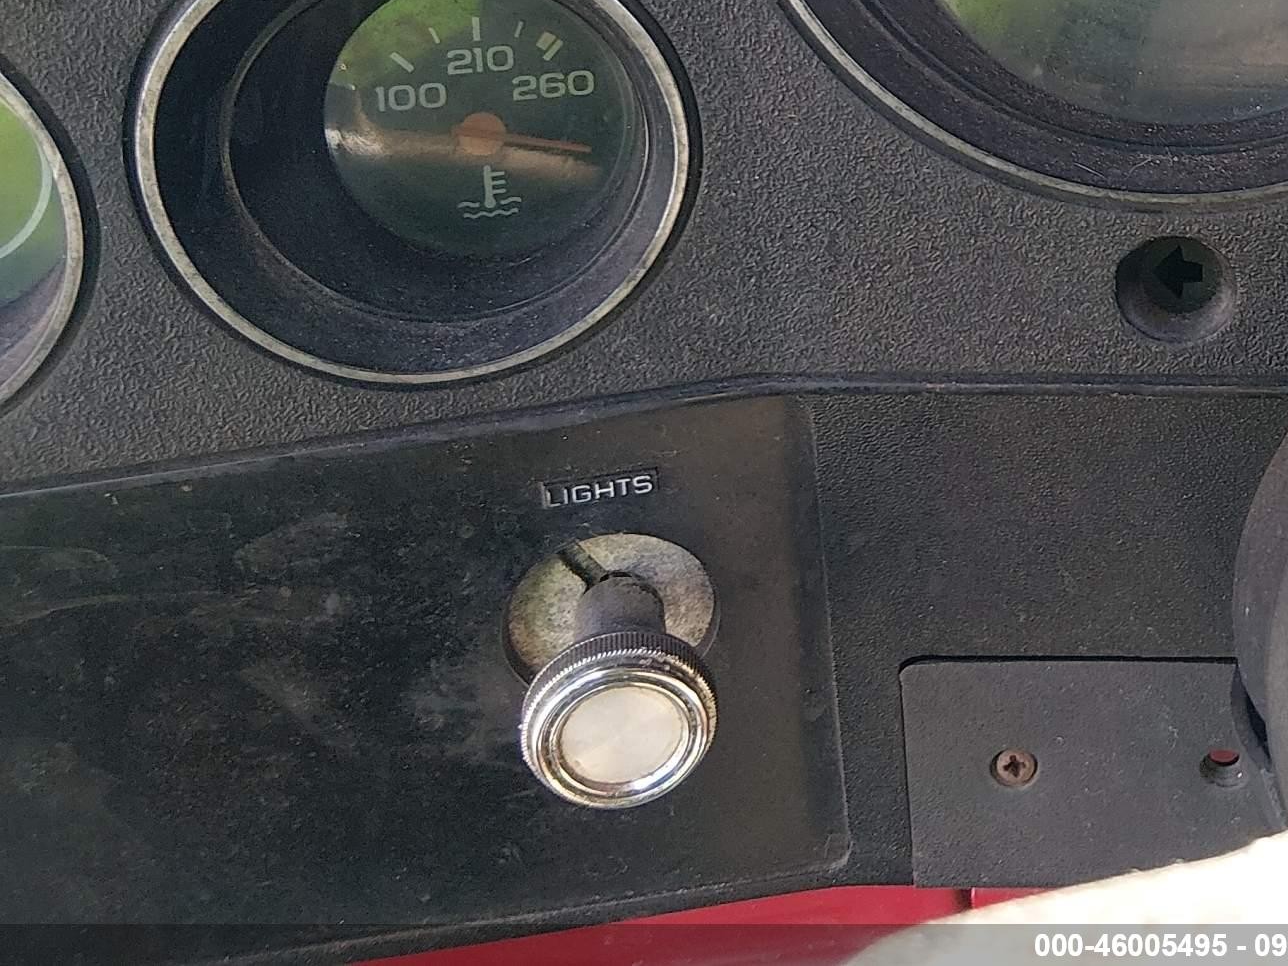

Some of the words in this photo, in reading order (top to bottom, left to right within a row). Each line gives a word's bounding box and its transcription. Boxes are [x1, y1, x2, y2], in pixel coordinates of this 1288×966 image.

[447, 45, 514, 75] 210
[376, 83, 447, 112] 100
[512, 70, 595, 101] 260
[546, 475, 653, 507] LIGHTS
